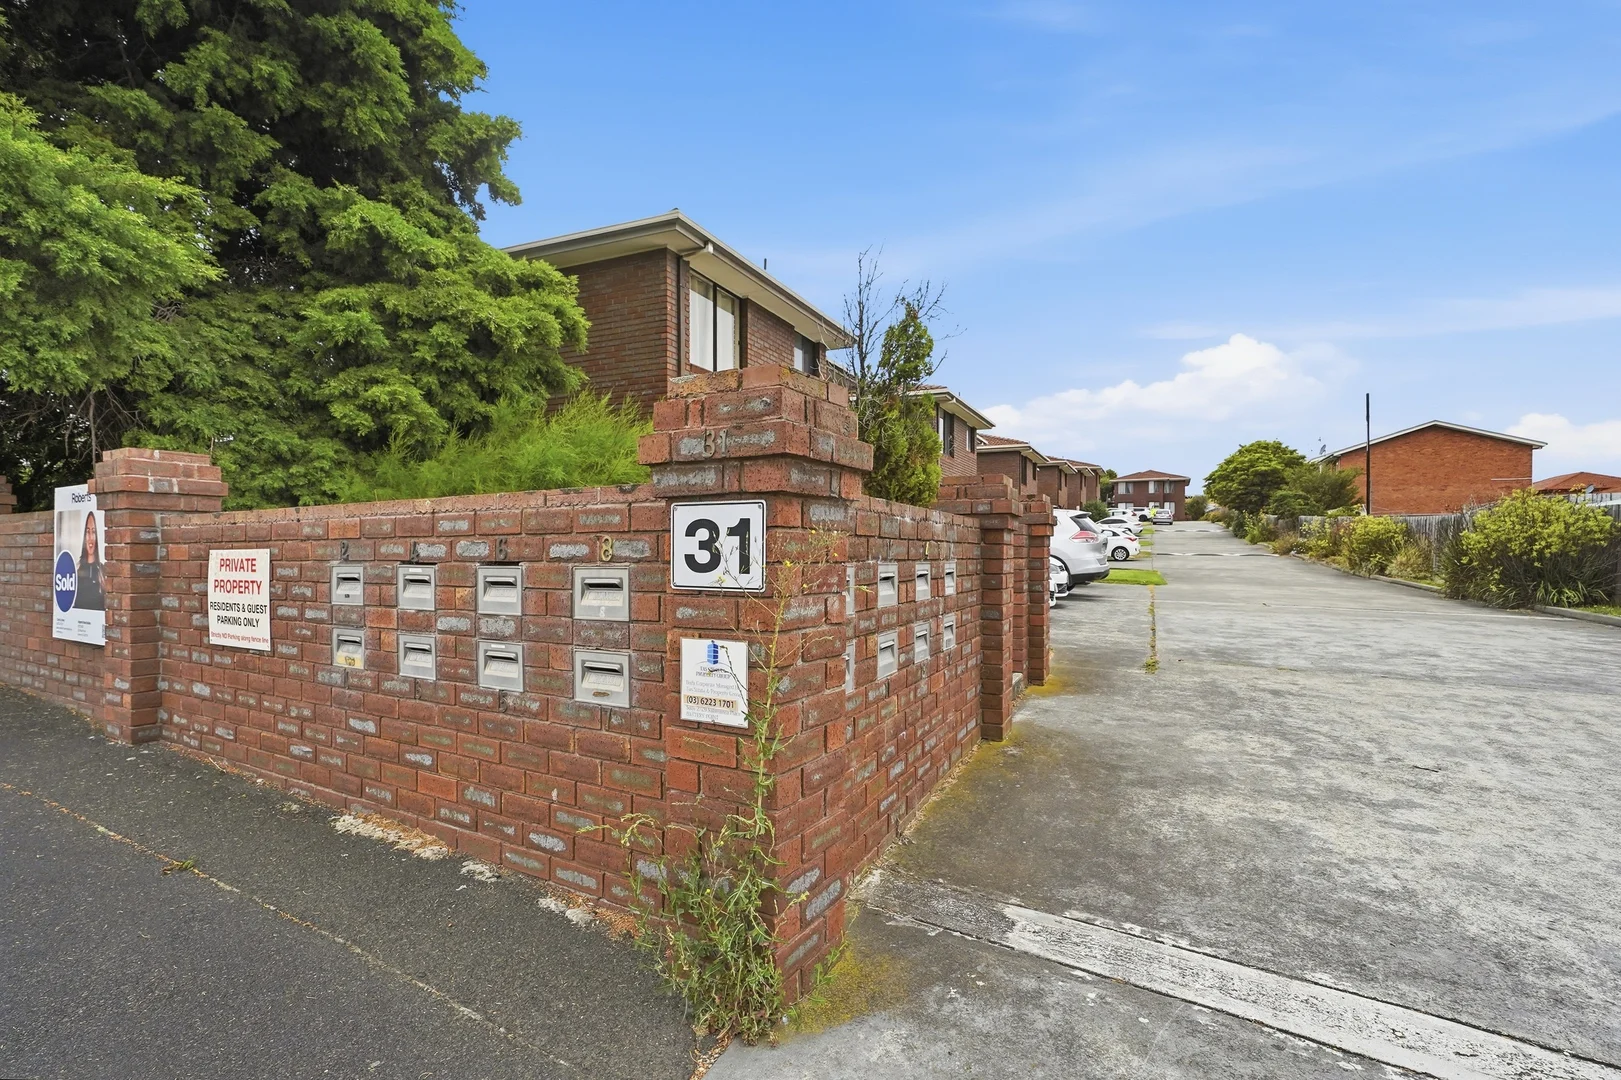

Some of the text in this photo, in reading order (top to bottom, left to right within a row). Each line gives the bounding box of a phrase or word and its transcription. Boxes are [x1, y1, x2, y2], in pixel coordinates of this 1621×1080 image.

[702, 428, 728, 458] 31
[497, 536, 507, 560] 6
[601, 535, 613, 562] 8
[684, 517, 751, 575] 31
[220, 558, 257, 573] PRIVATE
[55, 573, 76, 592] Sold
[214, 579, 262, 594] PROPERTY
[210, 602, 268, 615] RESIDENTS & GUEST
[217, 615, 260, 628] PARKING ONLY
[228, 633, 240, 641] Parking
[686, 696, 734, 708] (03) 6223 1701
